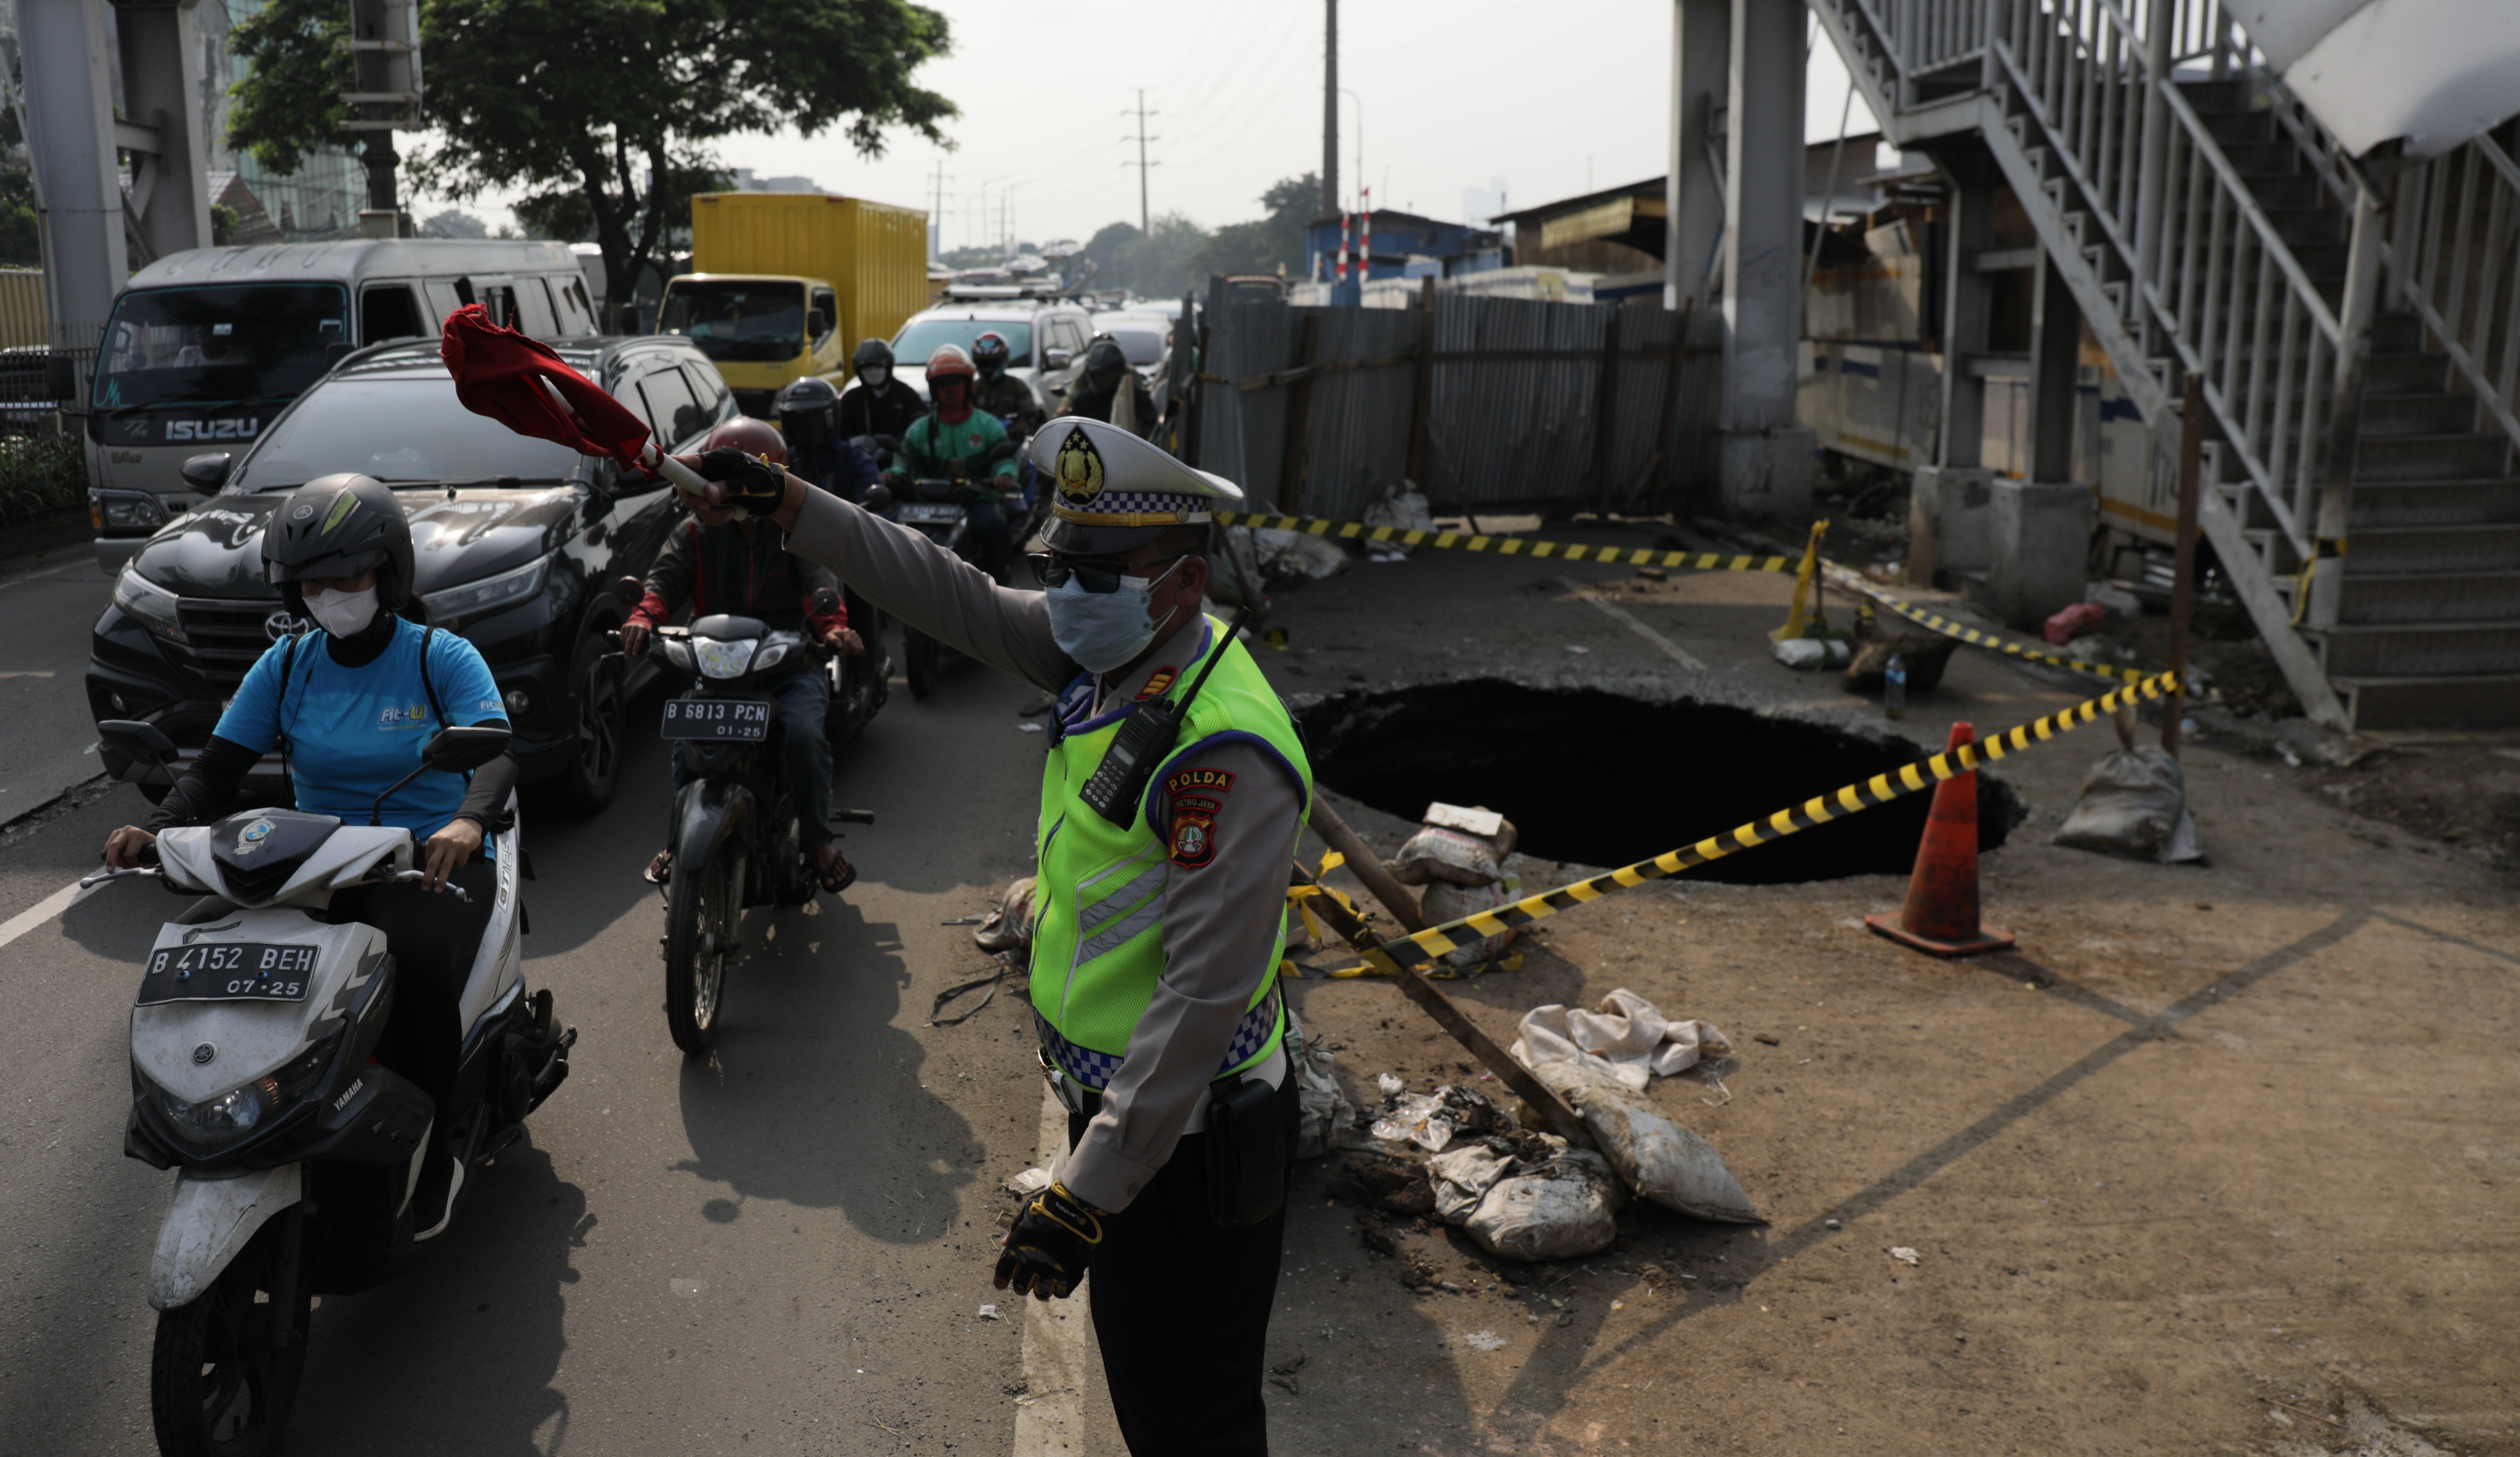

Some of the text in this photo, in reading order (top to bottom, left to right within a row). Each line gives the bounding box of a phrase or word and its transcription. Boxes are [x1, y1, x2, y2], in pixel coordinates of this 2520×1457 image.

[166, 418, 258, 440] ISUZU
[378, 704, 425, 724] Fit-U
[668, 704, 765, 722] B 6813 PCN
[1169, 771, 1227, 791] POLDA
[1176, 799, 1215, 810] METRO JAYA
[152, 948, 313, 974] B 4152 BEH
[334, 1078, 363, 1111] YAMAHA
